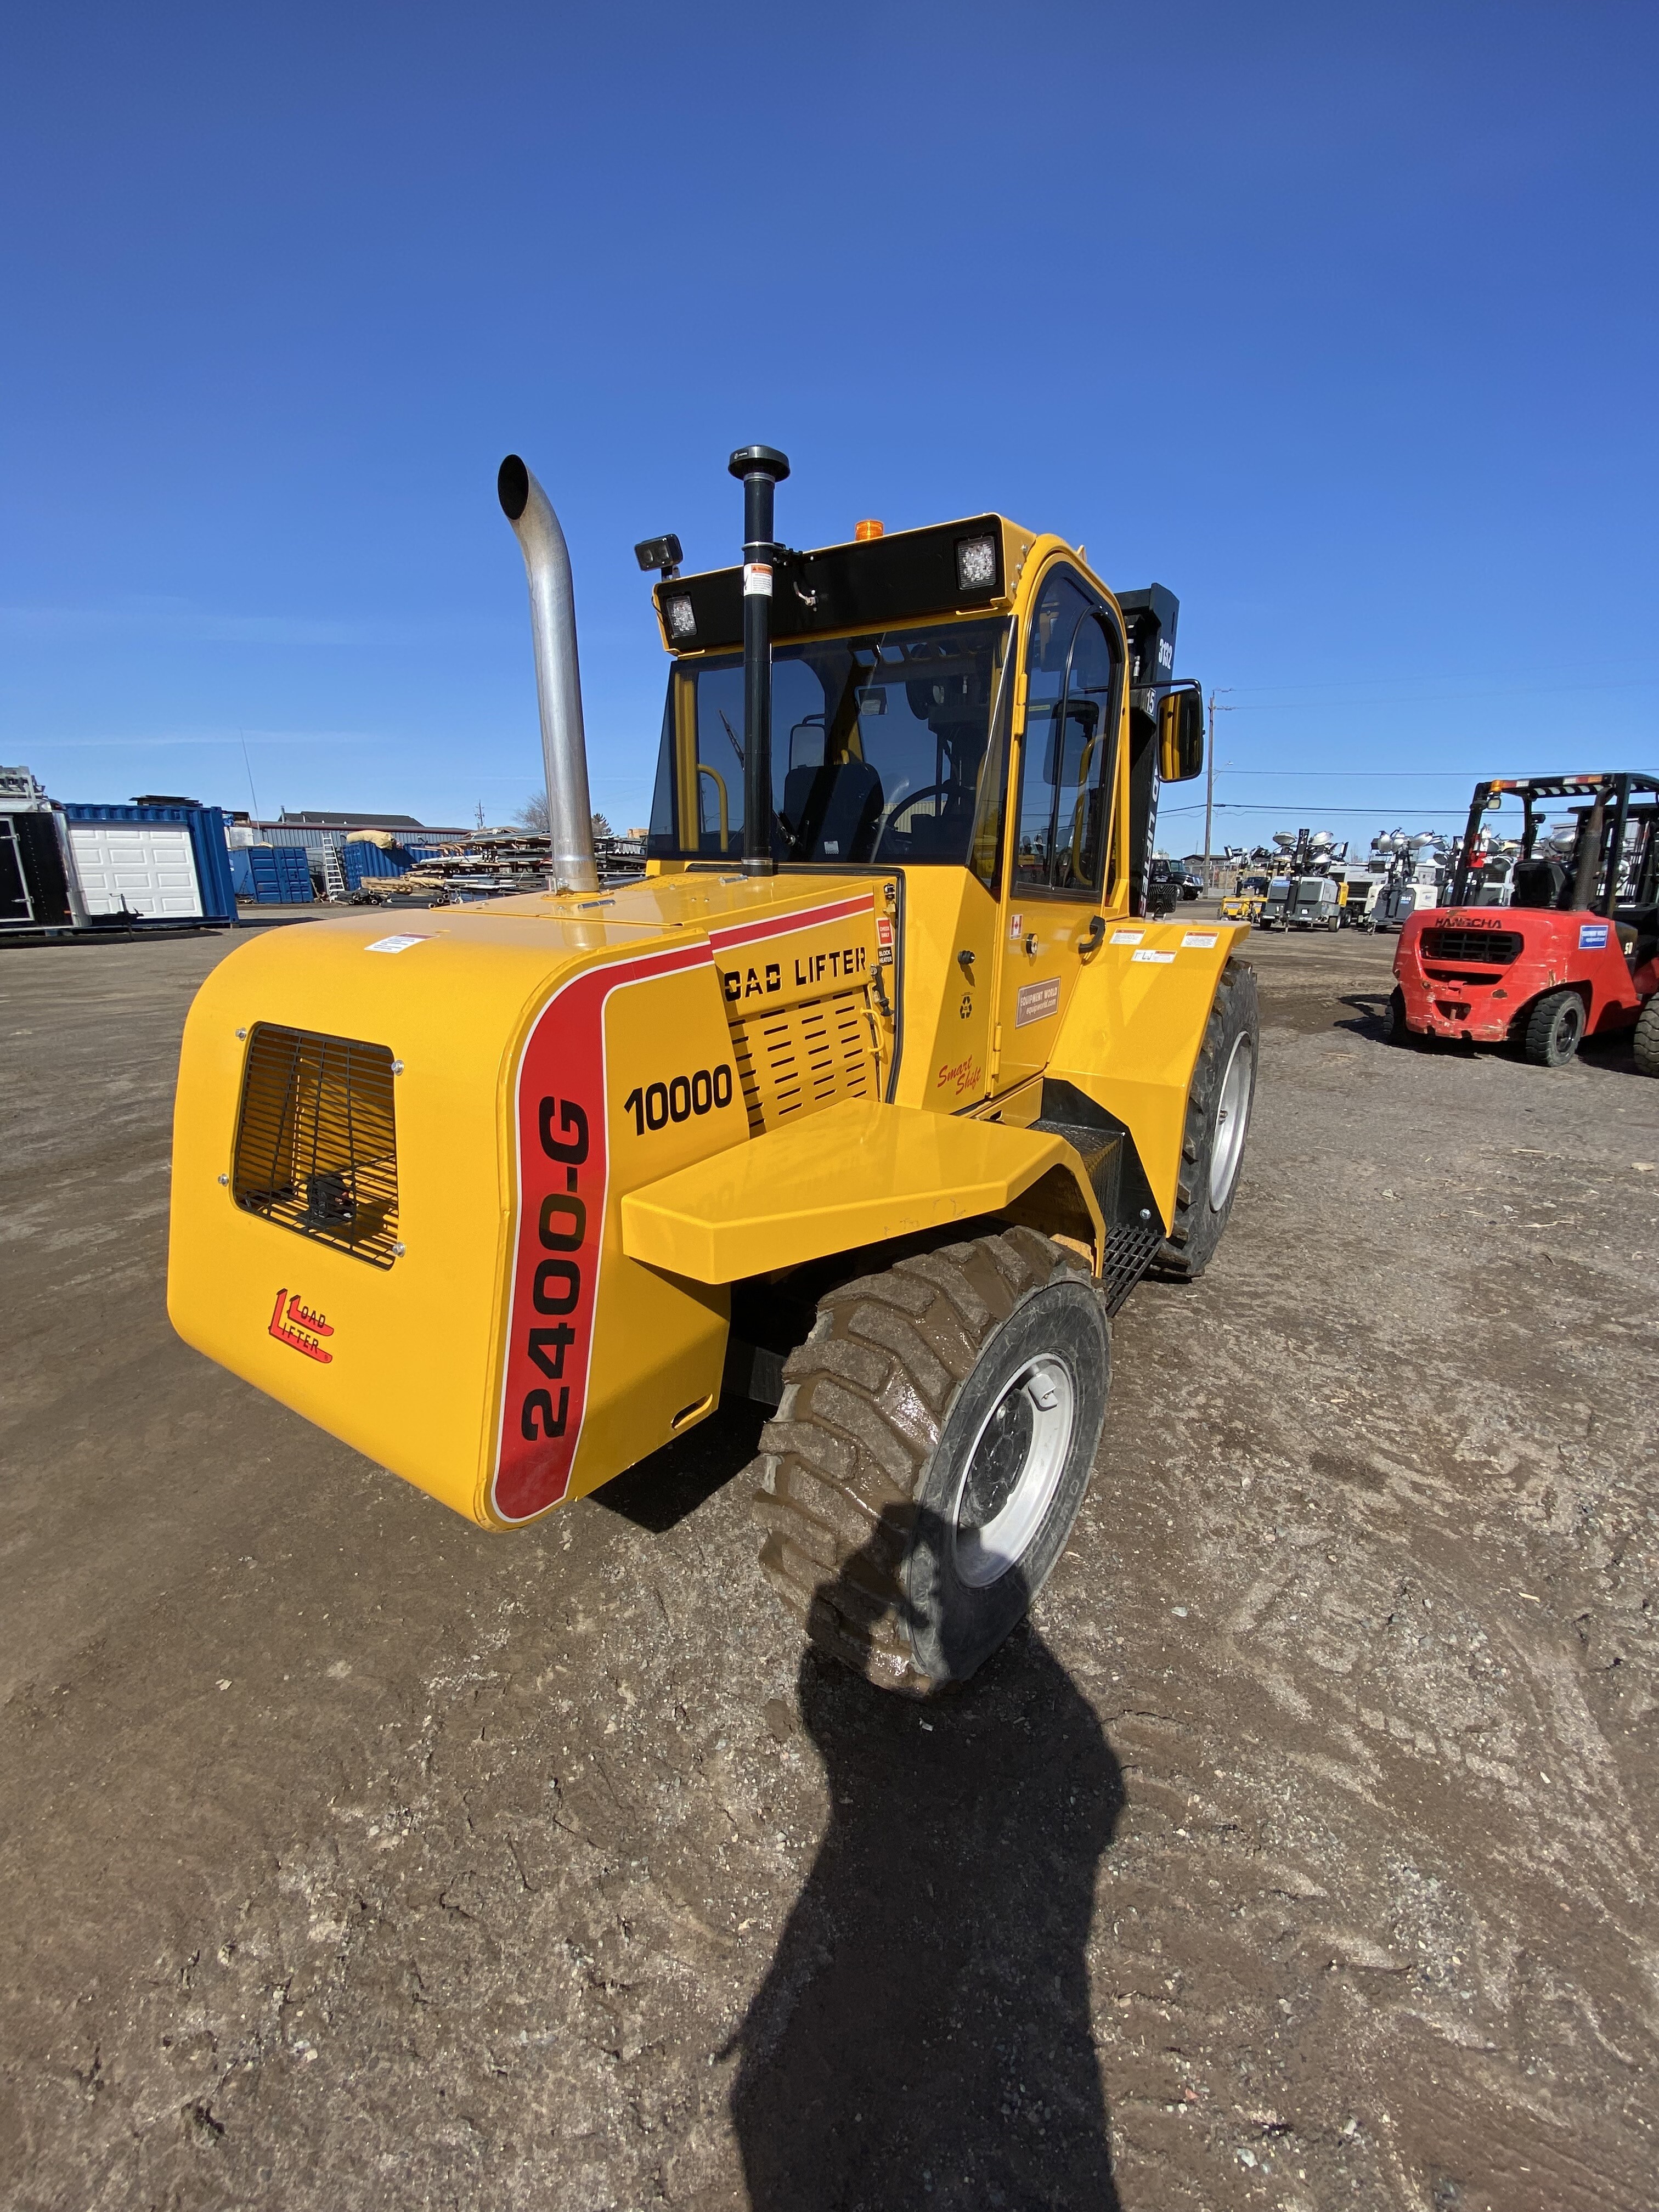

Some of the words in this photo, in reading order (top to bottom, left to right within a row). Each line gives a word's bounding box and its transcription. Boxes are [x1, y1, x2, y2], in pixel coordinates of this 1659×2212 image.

[1158, 638, 1173, 670] 3132
[1435, 918, 1502, 929] HANGCHA
[724, 963, 781, 1002] OAD
[794, 947, 866, 987] LIFTER
[1020, 991, 1043, 1007] EQUIPMENT
[1043, 986, 1058, 999] WORLD
[1026, 998, 1057, 1015] equipworld.com
[936, 1054, 972, 1088] Smart
[955, 1066, 981, 1096] Shift
[623, 1064, 733, 1136] 10000
[521, 1096, 589, 1442] 2400-G
[268, 1288, 333, 1364] LIFTER
[286, 1294, 334, 1337] LOAD
